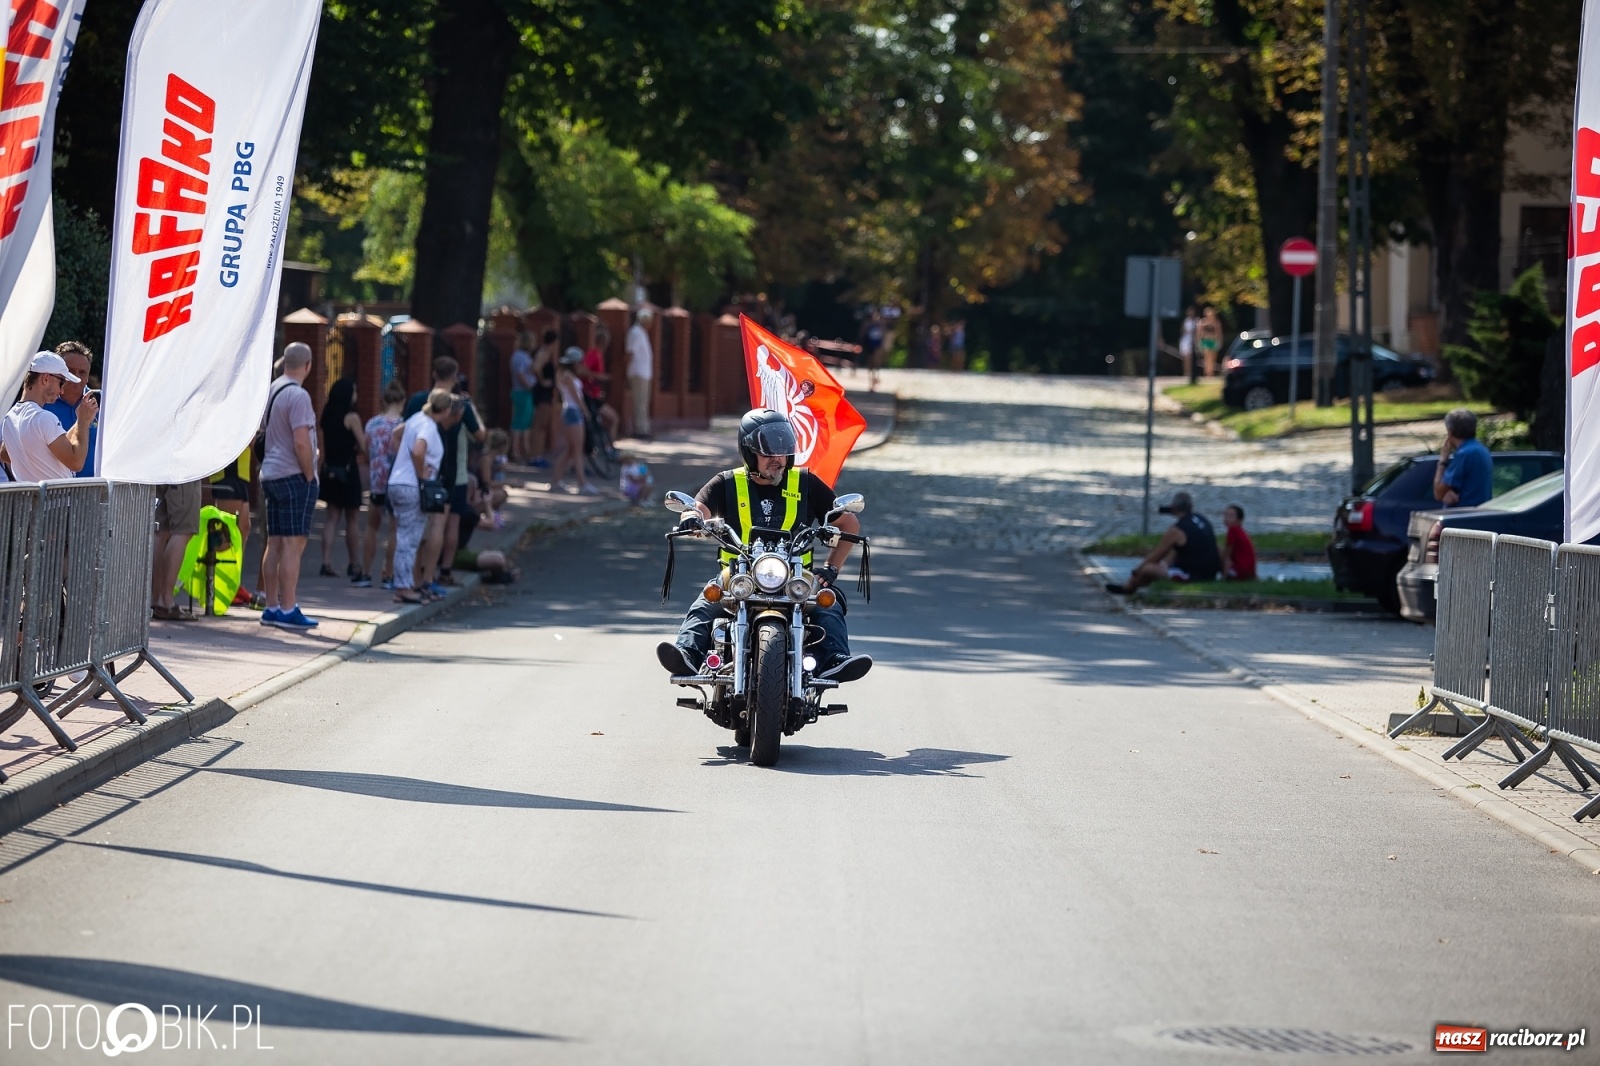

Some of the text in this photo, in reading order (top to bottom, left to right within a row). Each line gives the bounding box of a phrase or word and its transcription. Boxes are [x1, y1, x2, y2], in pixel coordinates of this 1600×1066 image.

[219, 141, 255, 289] GRUPA PBG
[275, 175, 285, 197] 1949
